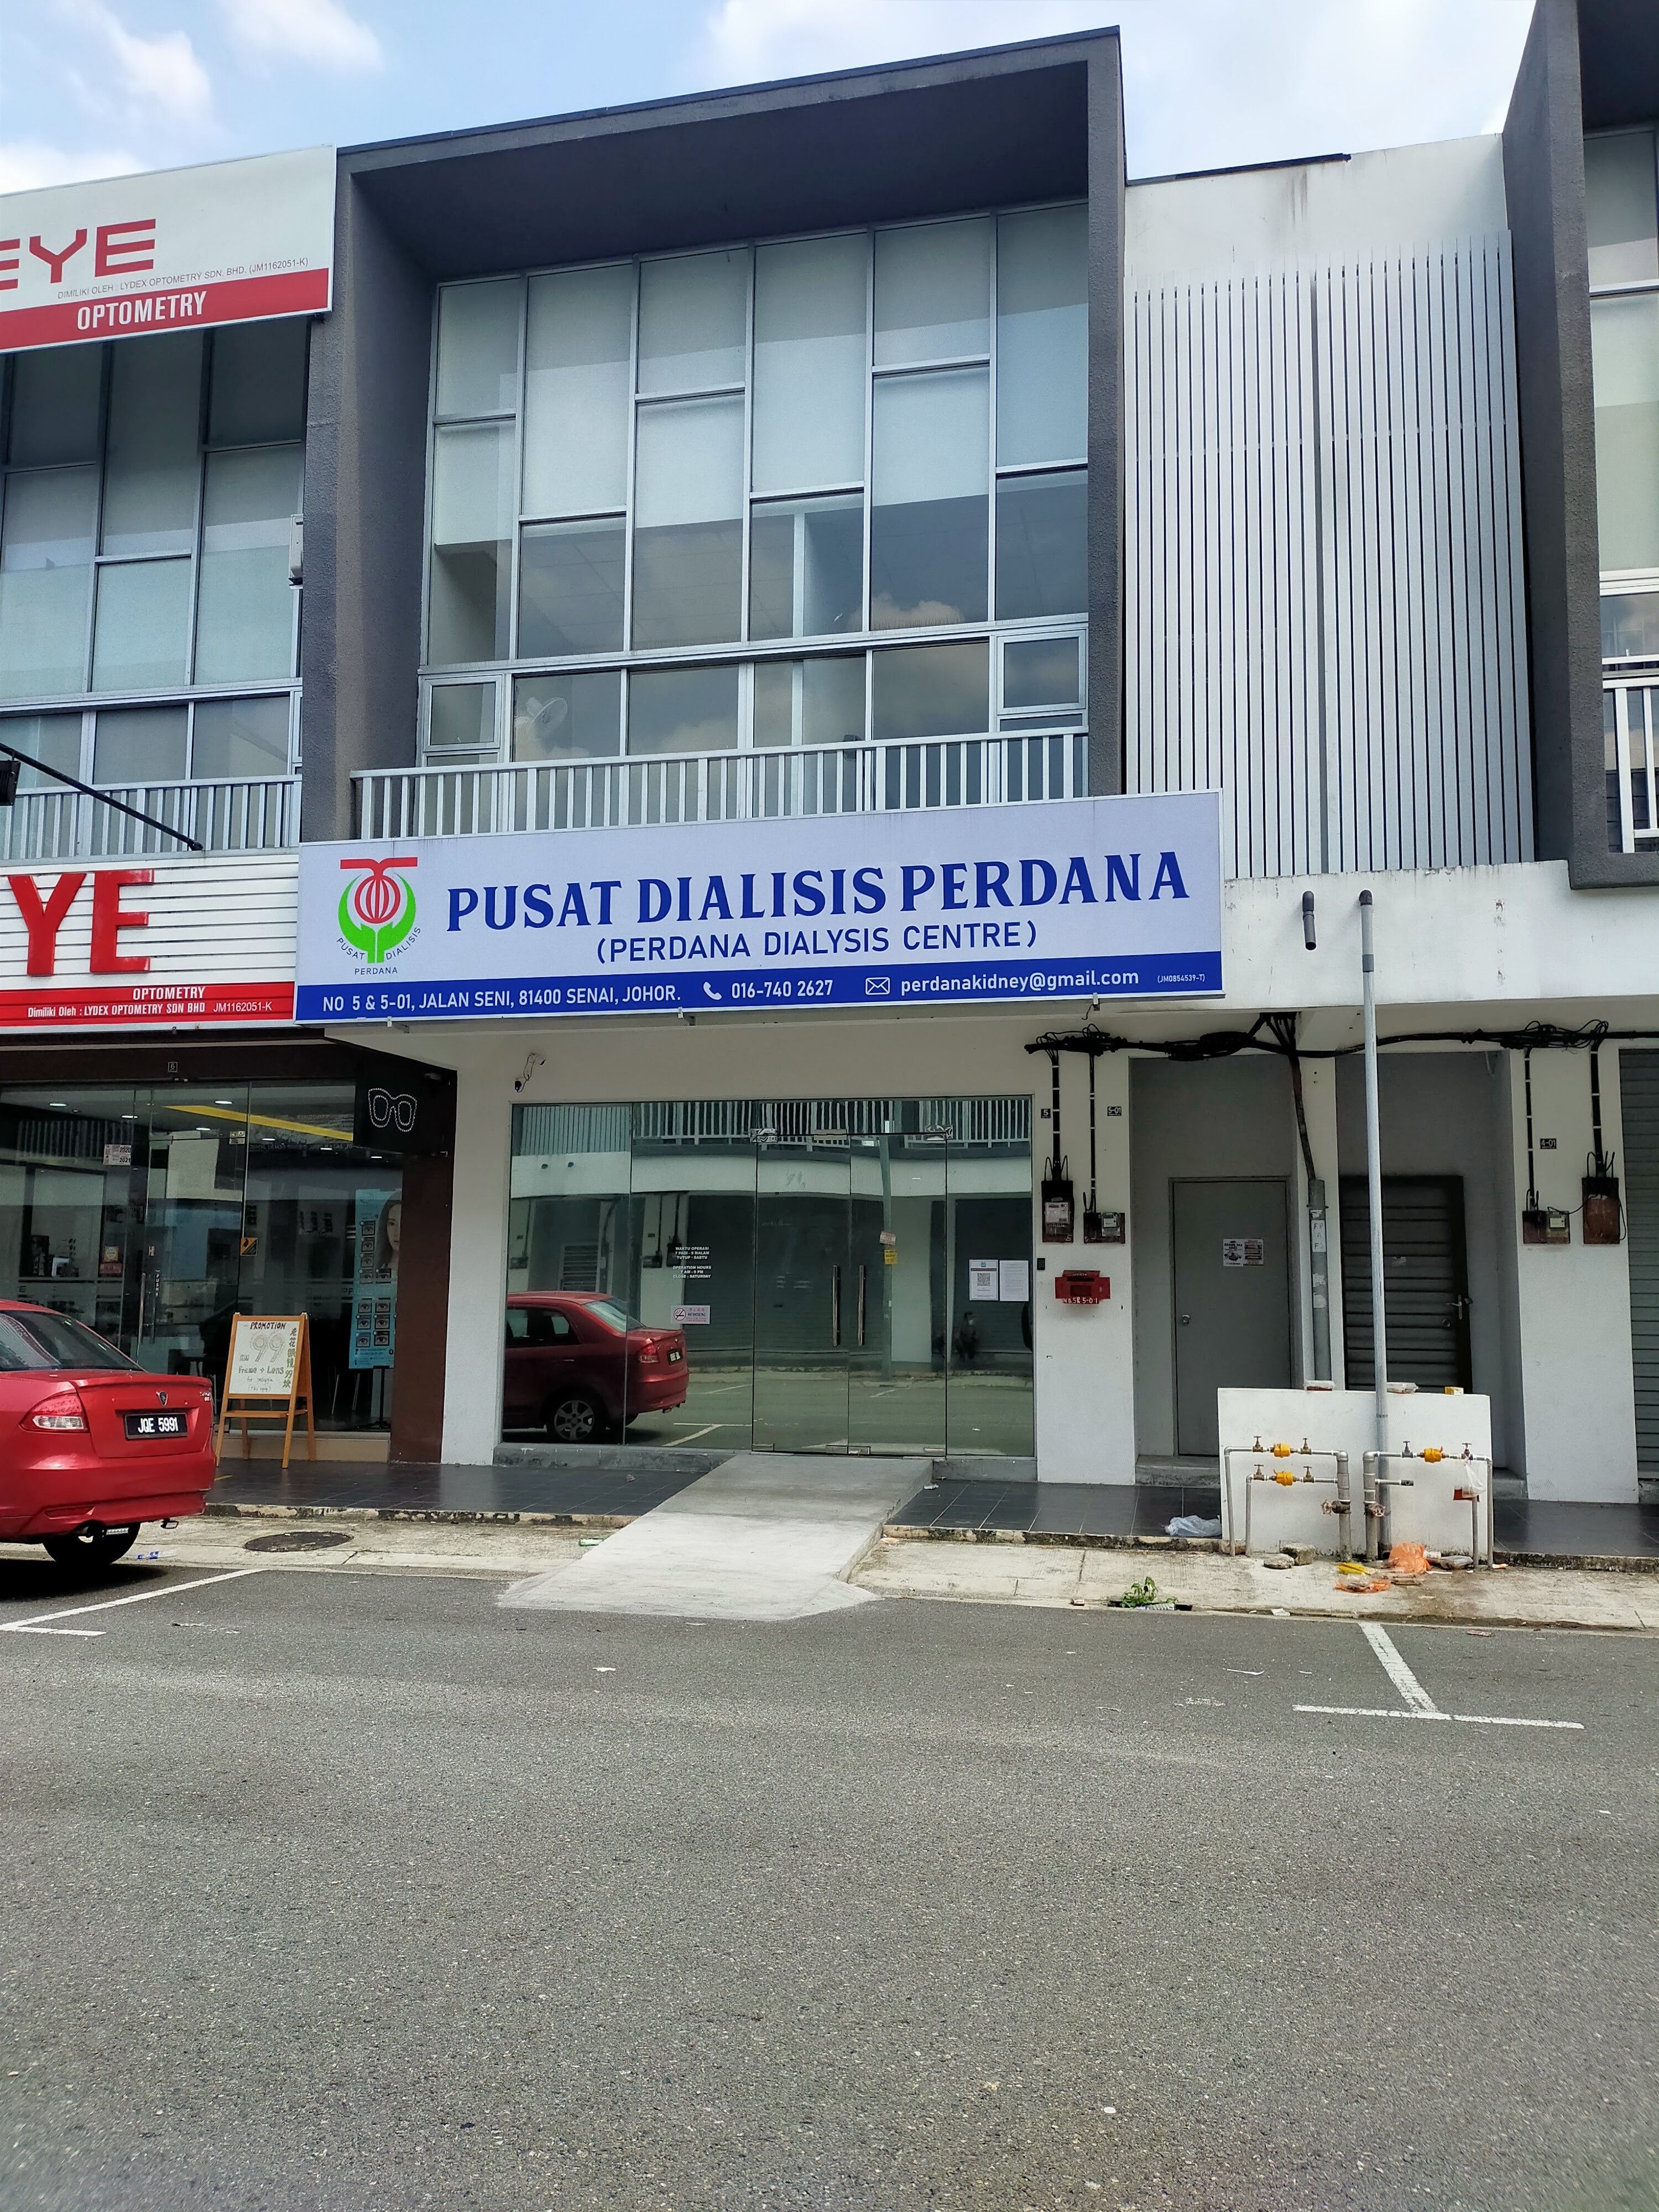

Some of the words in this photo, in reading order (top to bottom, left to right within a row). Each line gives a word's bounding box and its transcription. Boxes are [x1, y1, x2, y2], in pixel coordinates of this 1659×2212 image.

[58, 289, 89, 299] DIMILIKI
[91, 284, 114, 295] OLEH
[120, 279, 147, 291] LYDEX
[149, 271, 202, 287] OPTOMETRY
[205, 268, 224, 280] SDN.
[227, 265, 247, 277] BHD.
[249, 258, 309, 276] (JM1162051-K)
[77, 291, 207, 331] OPTOMETRY
[446, 880, 623, 932] PUSAT
[637, 867, 886, 924] DIALISIS
[900, 851, 1190, 911] PERDANA
[8, 869, 155, 977] YE
[336, 937, 366, 961] PUSAT
[385, 926, 421, 961] DIALISIS
[597, 933, 751, 964] (PERDANA
[764, 927, 890, 956] DIALYSIS
[903, 920, 1037, 951] CENTRE)
[354, 967, 398, 975] PERDANA
[133, 986, 206, 1001] OPTOMETRY
[323, 996, 344, 1012] NO
[352, 995, 361, 1011] 5
[366, 994, 376, 1011] &
[380, 993, 415, 1012] 5-01,
[419, 992, 469, 1009] JALAN
[474, 990, 514, 1009] SENI,
[519, 988, 561, 1005] 81400
[566, 986, 619, 1005] SENAI,
[622, 984, 681, 1003] JOHOR.
[731, 980, 792, 999] 016-740
[797, 979, 833, 997] 2627
[900, 969, 1139, 997] perdanakidney@gmail.com
[28, 1006, 56, 1018] Dimiliki
[59, 1005, 76, 1017] Oleh
[84, 1005, 108, 1016] LYDEX
[111, 1003, 163, 1015] OPTOMETRY
[166, 1003, 184, 1014] SDN
[187, 1002, 206, 1013] BHD
[213, 1001, 273, 1013] JM1162051-K
[250, 1322, 286, 1330] PROMOTION
[138, 1418, 155, 1433] JQE
[158, 1417, 179, 1432] 5991
